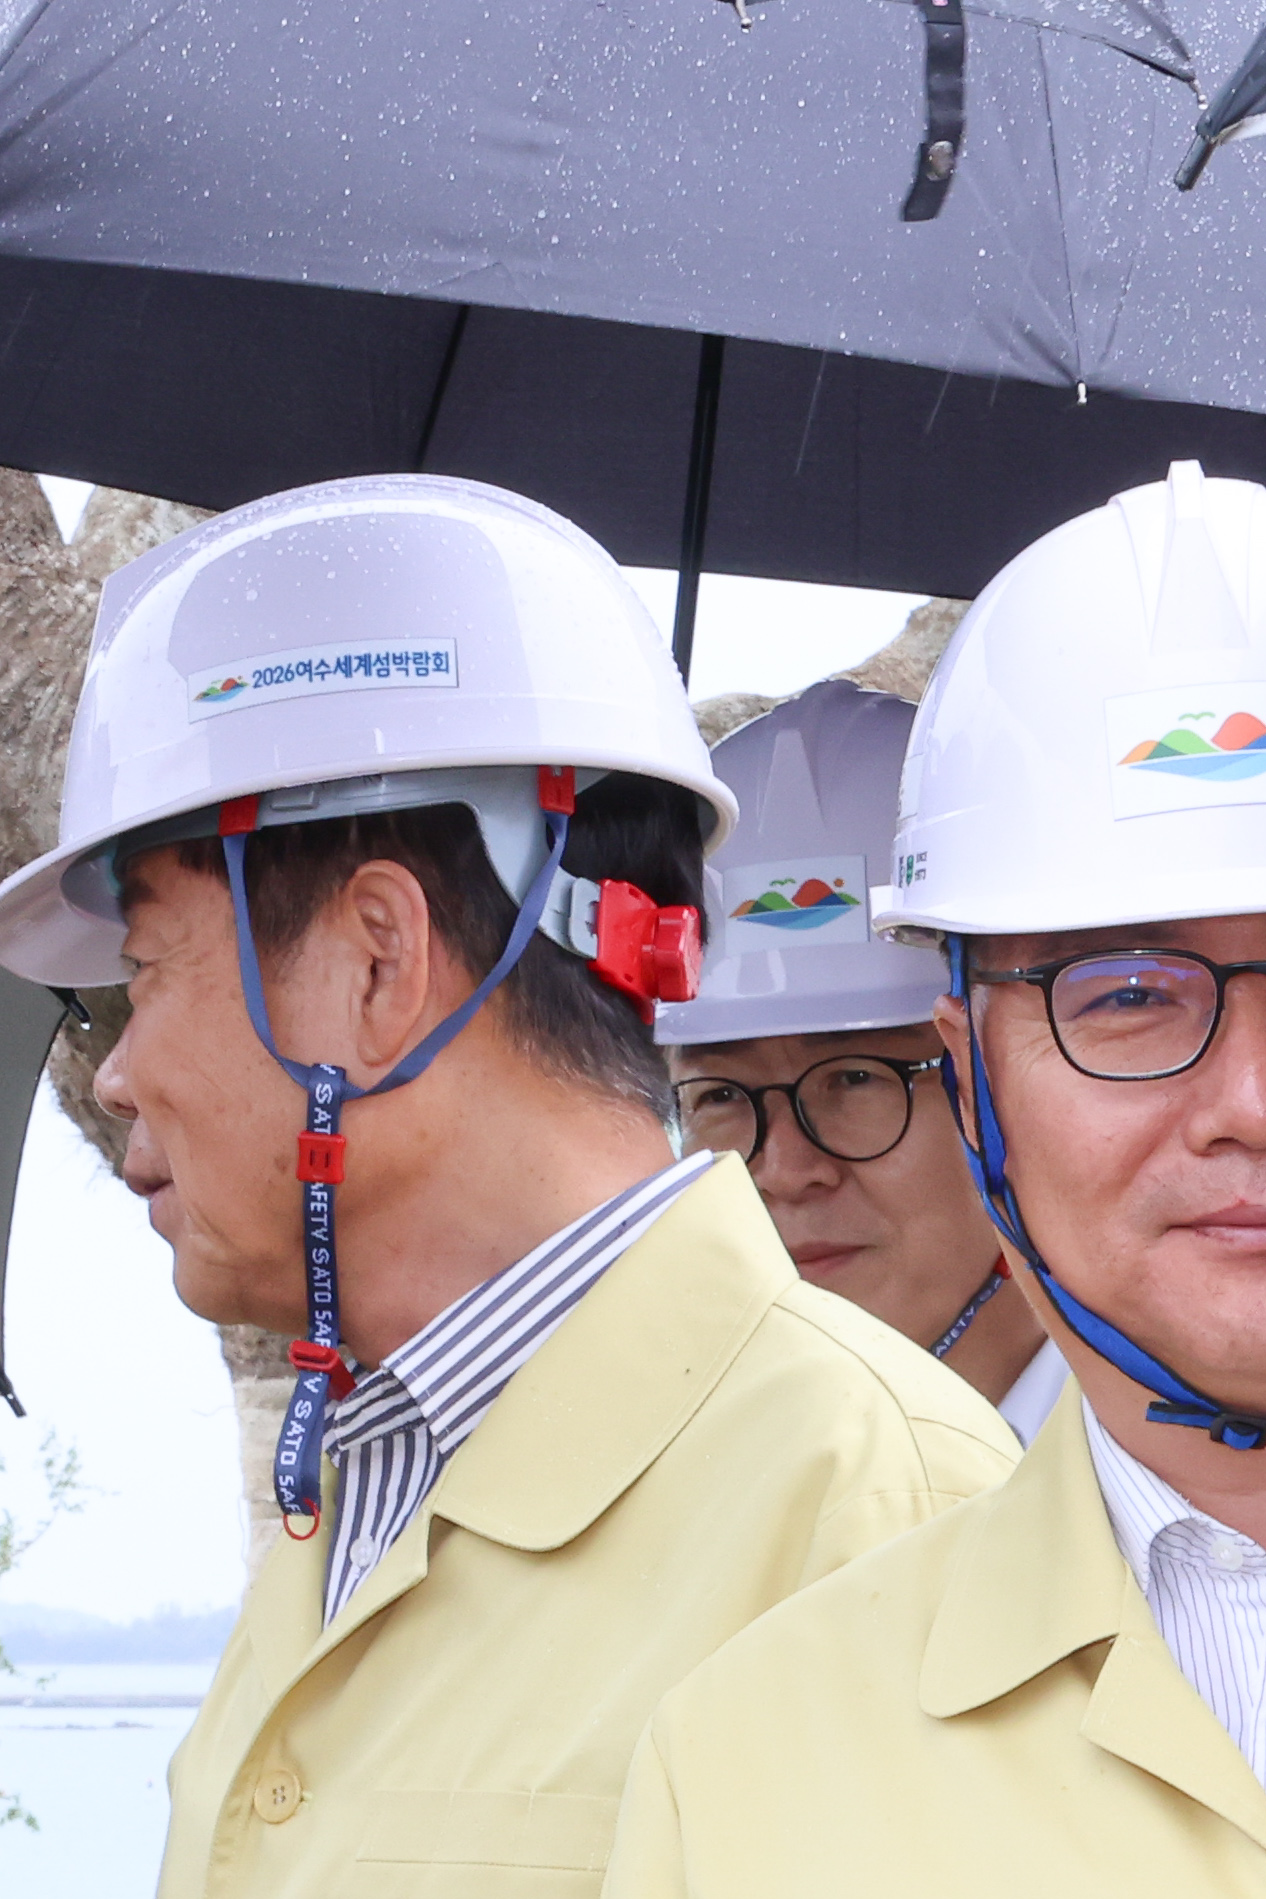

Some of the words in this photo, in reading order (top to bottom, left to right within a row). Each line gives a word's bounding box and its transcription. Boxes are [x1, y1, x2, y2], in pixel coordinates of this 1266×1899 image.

[252, 650, 450, 689] 2026여수세계섬박람회
[314, 1083, 334, 1136] SAT
[312, 1248, 332, 1303] SATO
[313, 1310, 332, 1349] SAF
[279, 1399, 313, 1466] SATO
